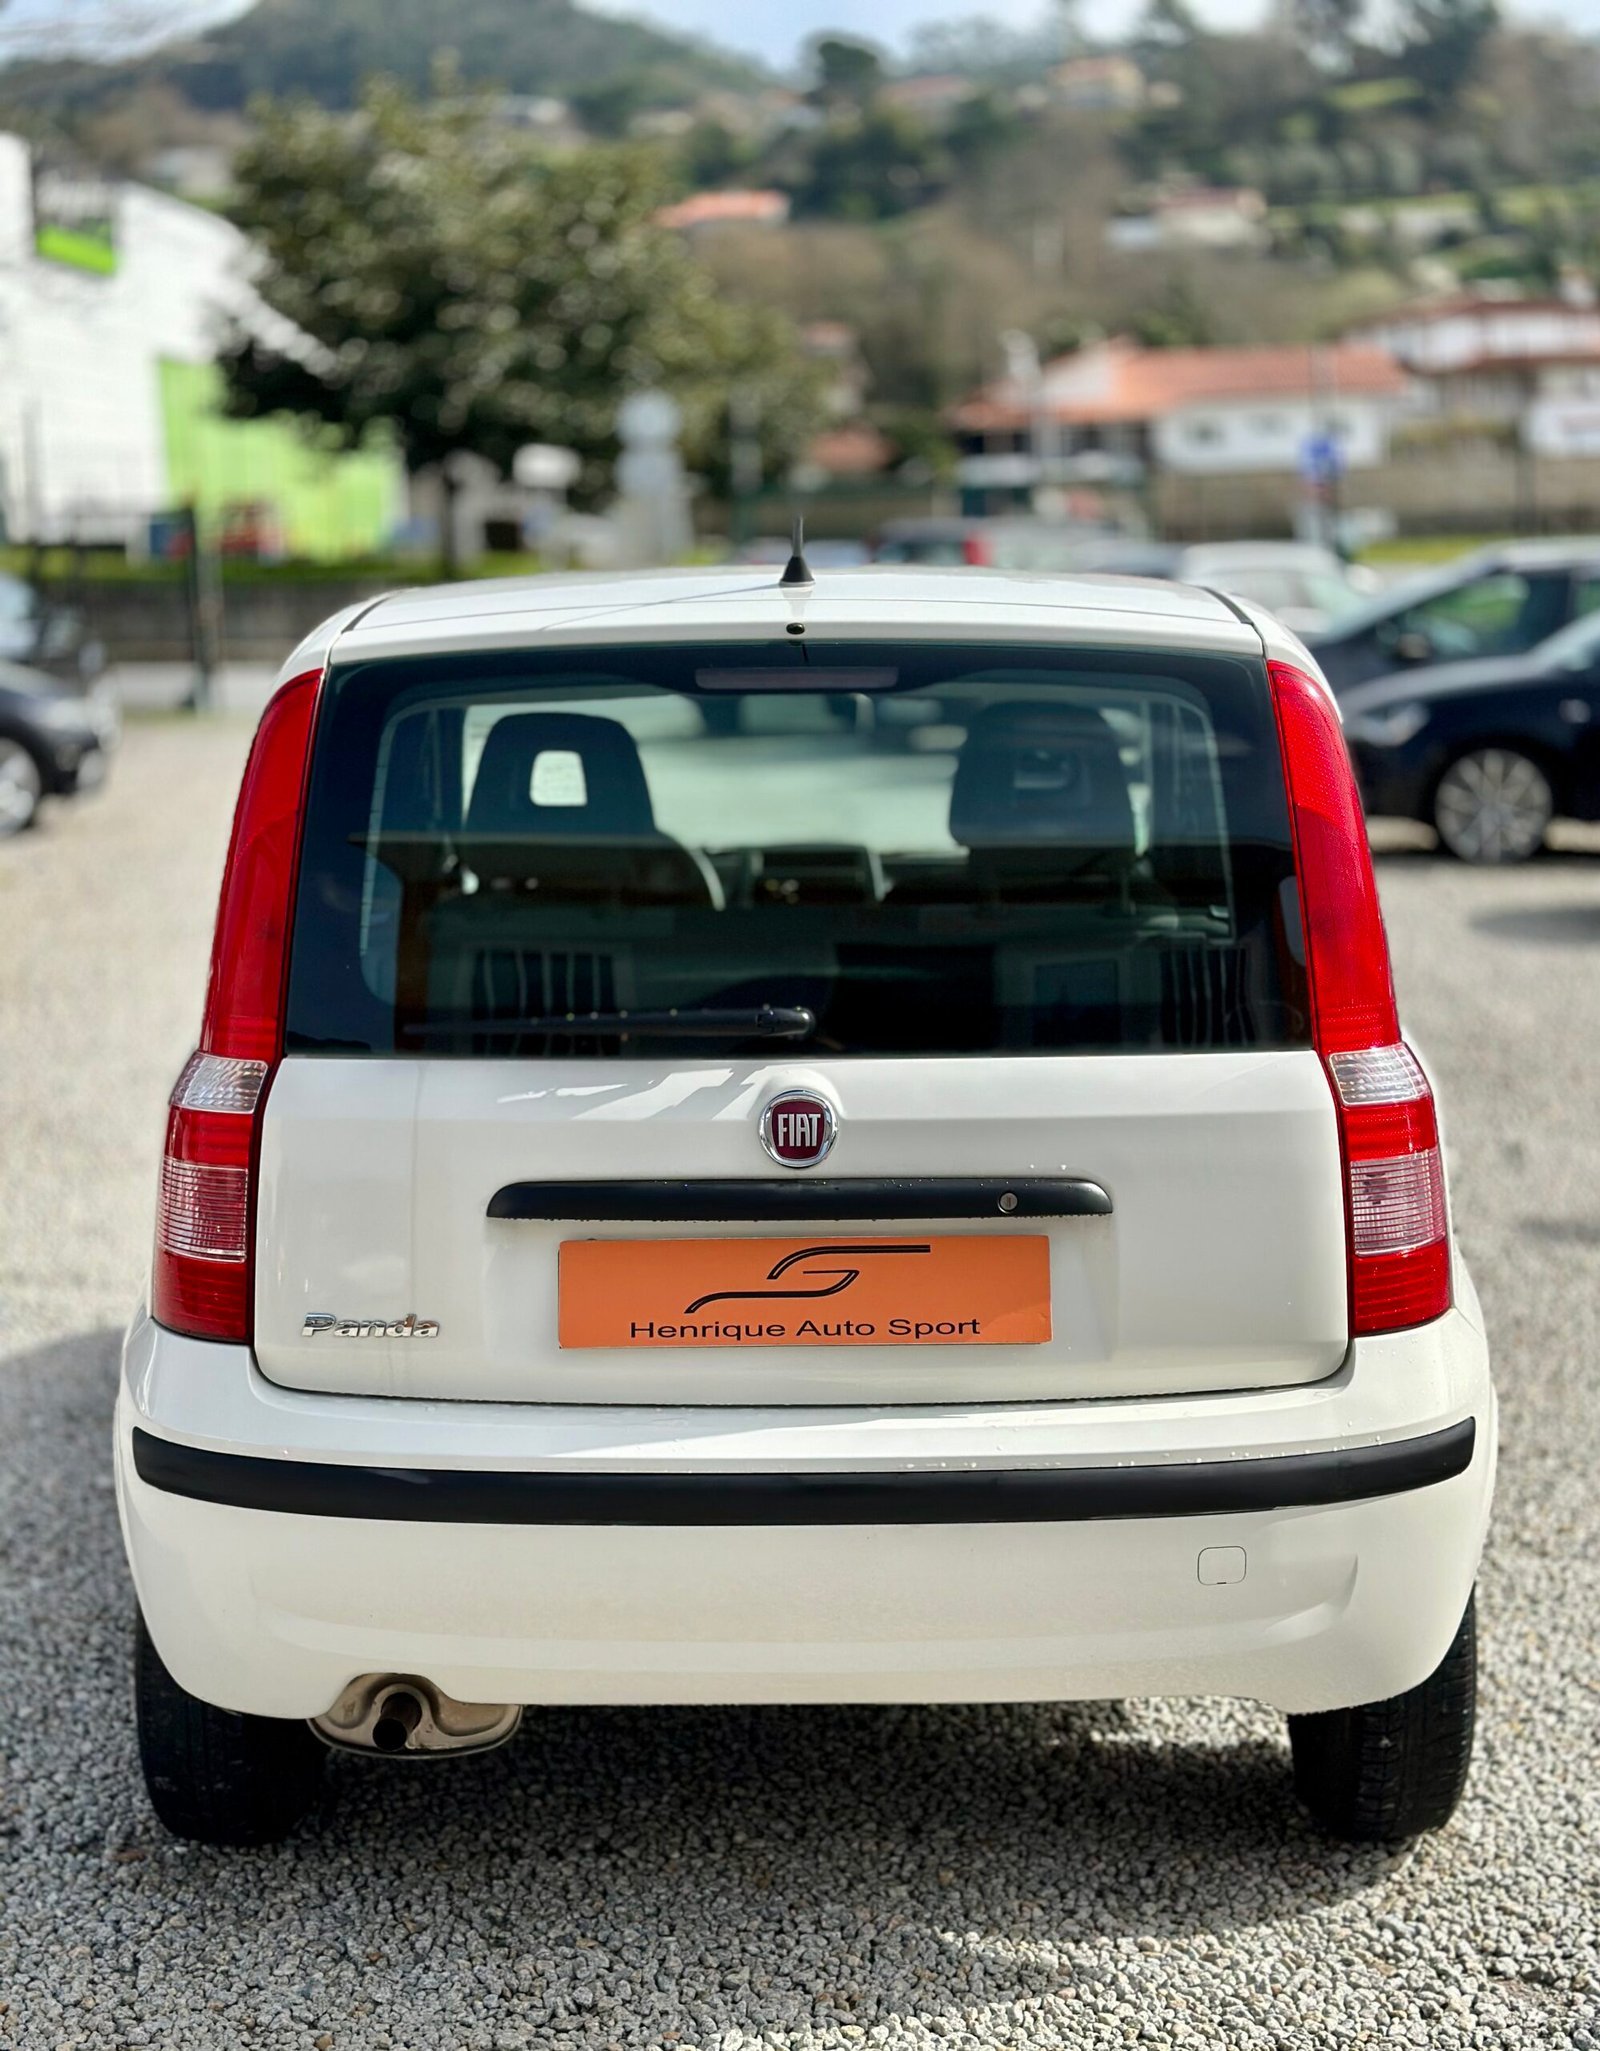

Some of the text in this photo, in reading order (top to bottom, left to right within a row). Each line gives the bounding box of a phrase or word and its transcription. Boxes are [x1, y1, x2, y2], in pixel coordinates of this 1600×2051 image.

[778, 1113, 821, 1147] FIAT
[301, 1312, 439, 1338] Panda
[630, 1318, 981, 1341] Henrique Auto Sport
